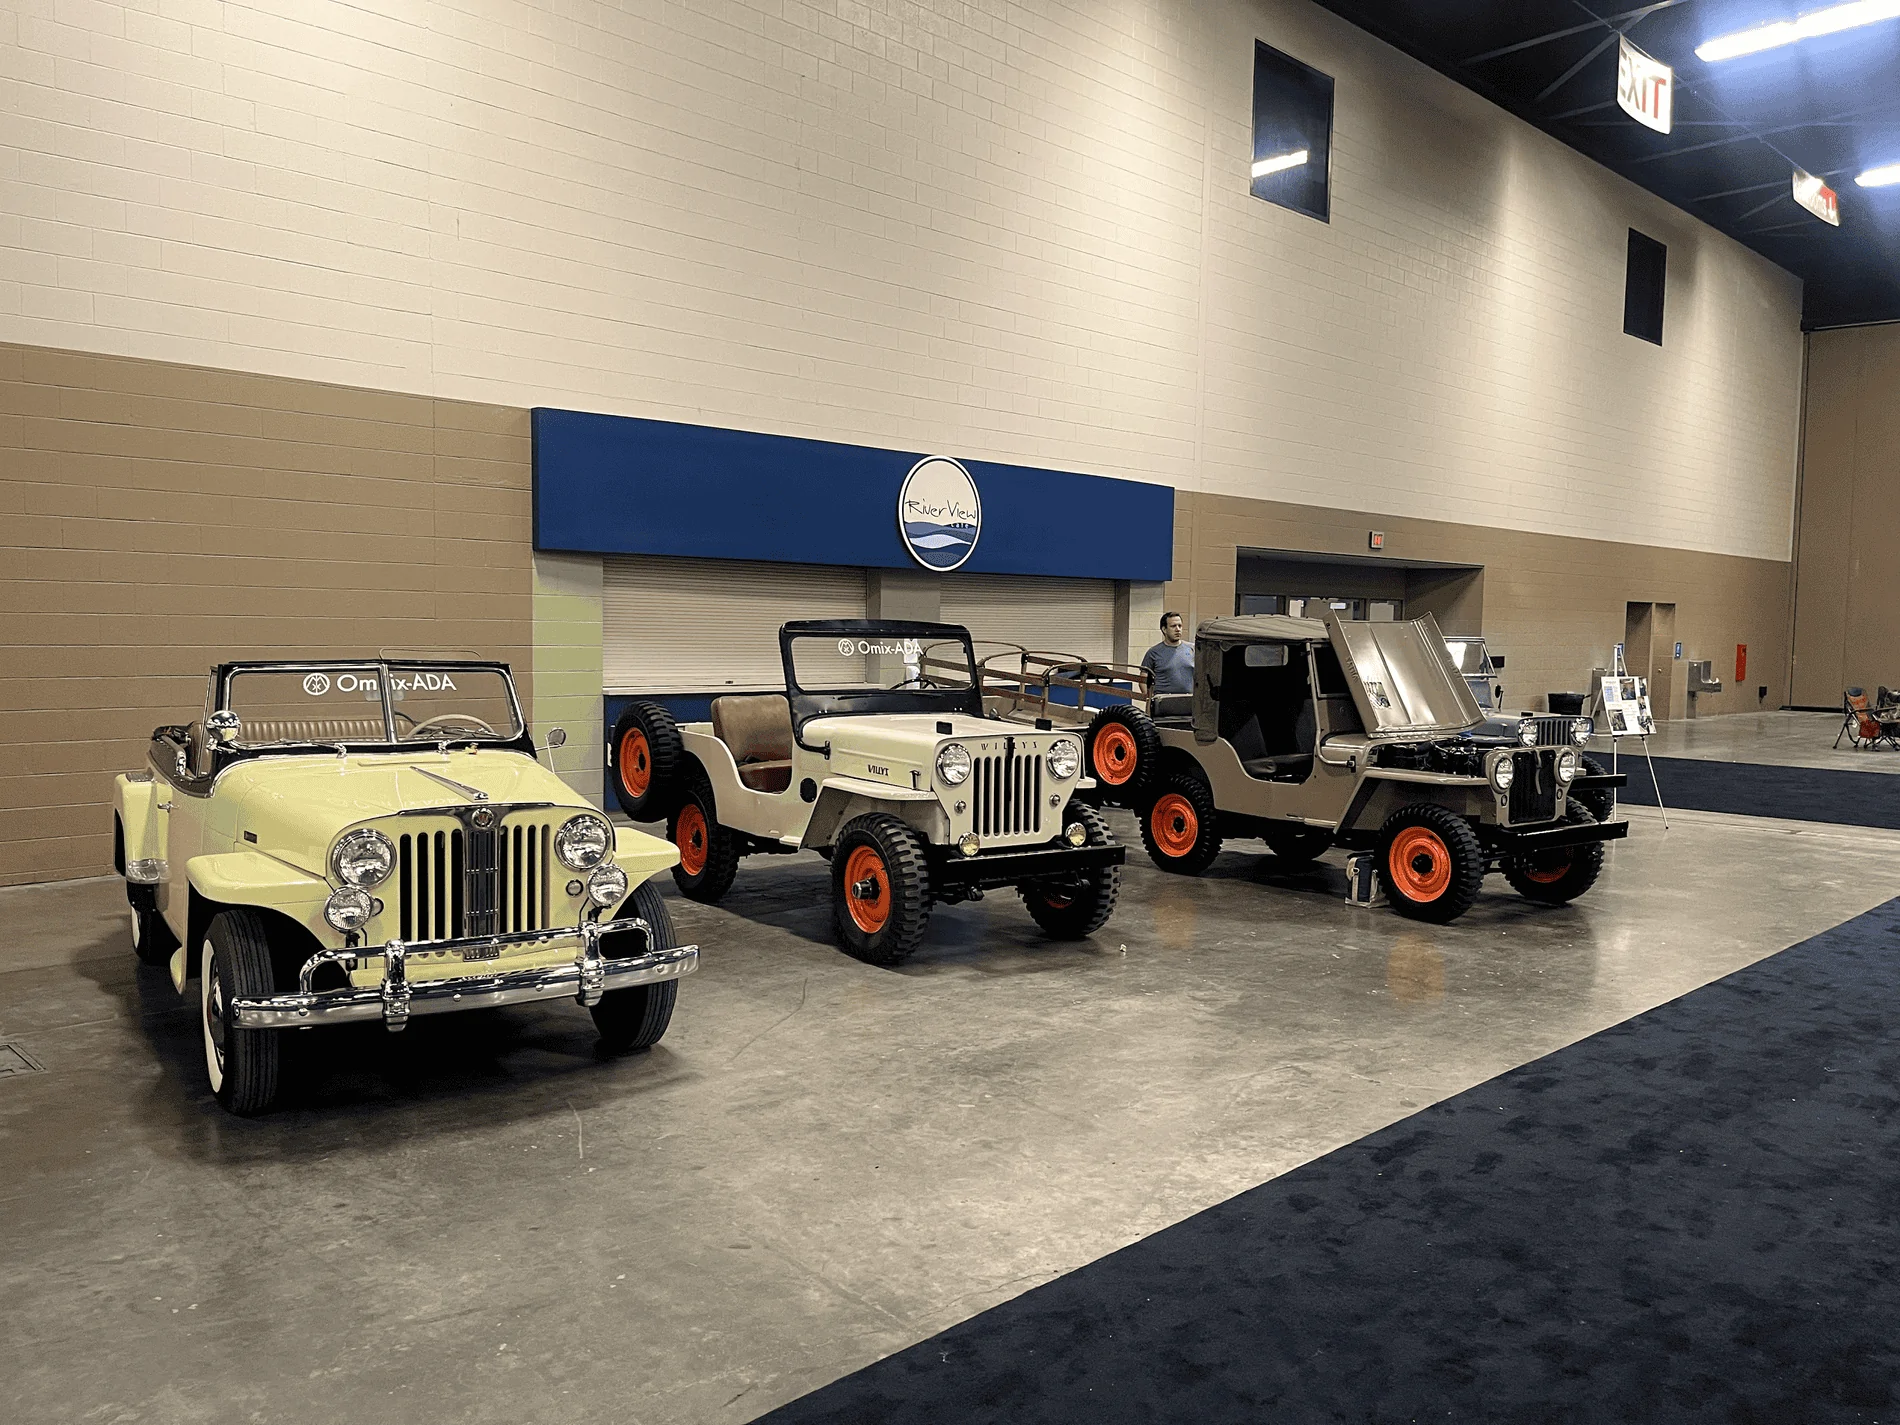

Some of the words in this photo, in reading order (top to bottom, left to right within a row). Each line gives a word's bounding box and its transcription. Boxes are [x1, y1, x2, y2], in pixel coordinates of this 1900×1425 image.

[1618, 46, 1667, 119] EXIT
[905, 498, 947, 517] River
[947, 499, 977, 520] View
[857, 640, 924, 655] Omix-ADA
